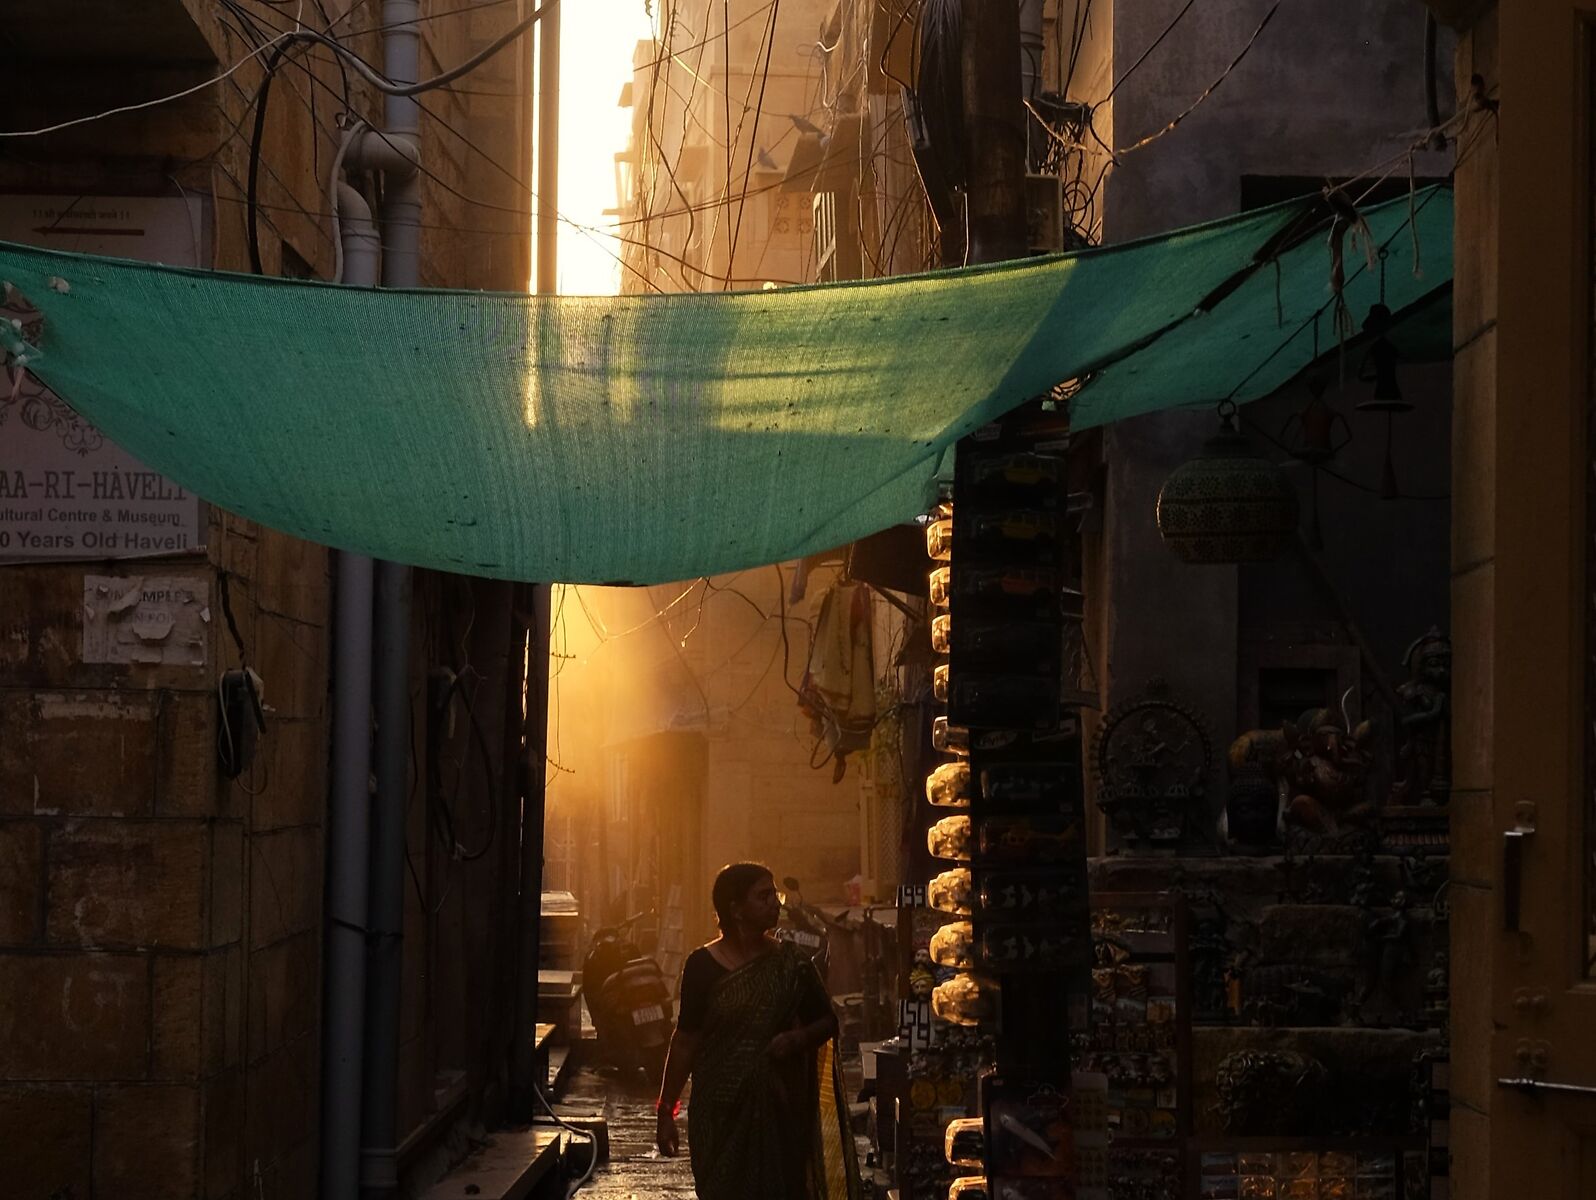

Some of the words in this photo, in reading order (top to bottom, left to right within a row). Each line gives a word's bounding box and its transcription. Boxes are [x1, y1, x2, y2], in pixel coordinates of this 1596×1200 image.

[48, 508, 97, 522] Centre
[102, 509, 113, 522] &
[118, 509, 180, 525] Museum
[18, 531, 75, 549] Years
[82, 531, 117, 549] Old
[124, 533, 187, 550] Haveli
[900, 1000, 930, 1027] 150
